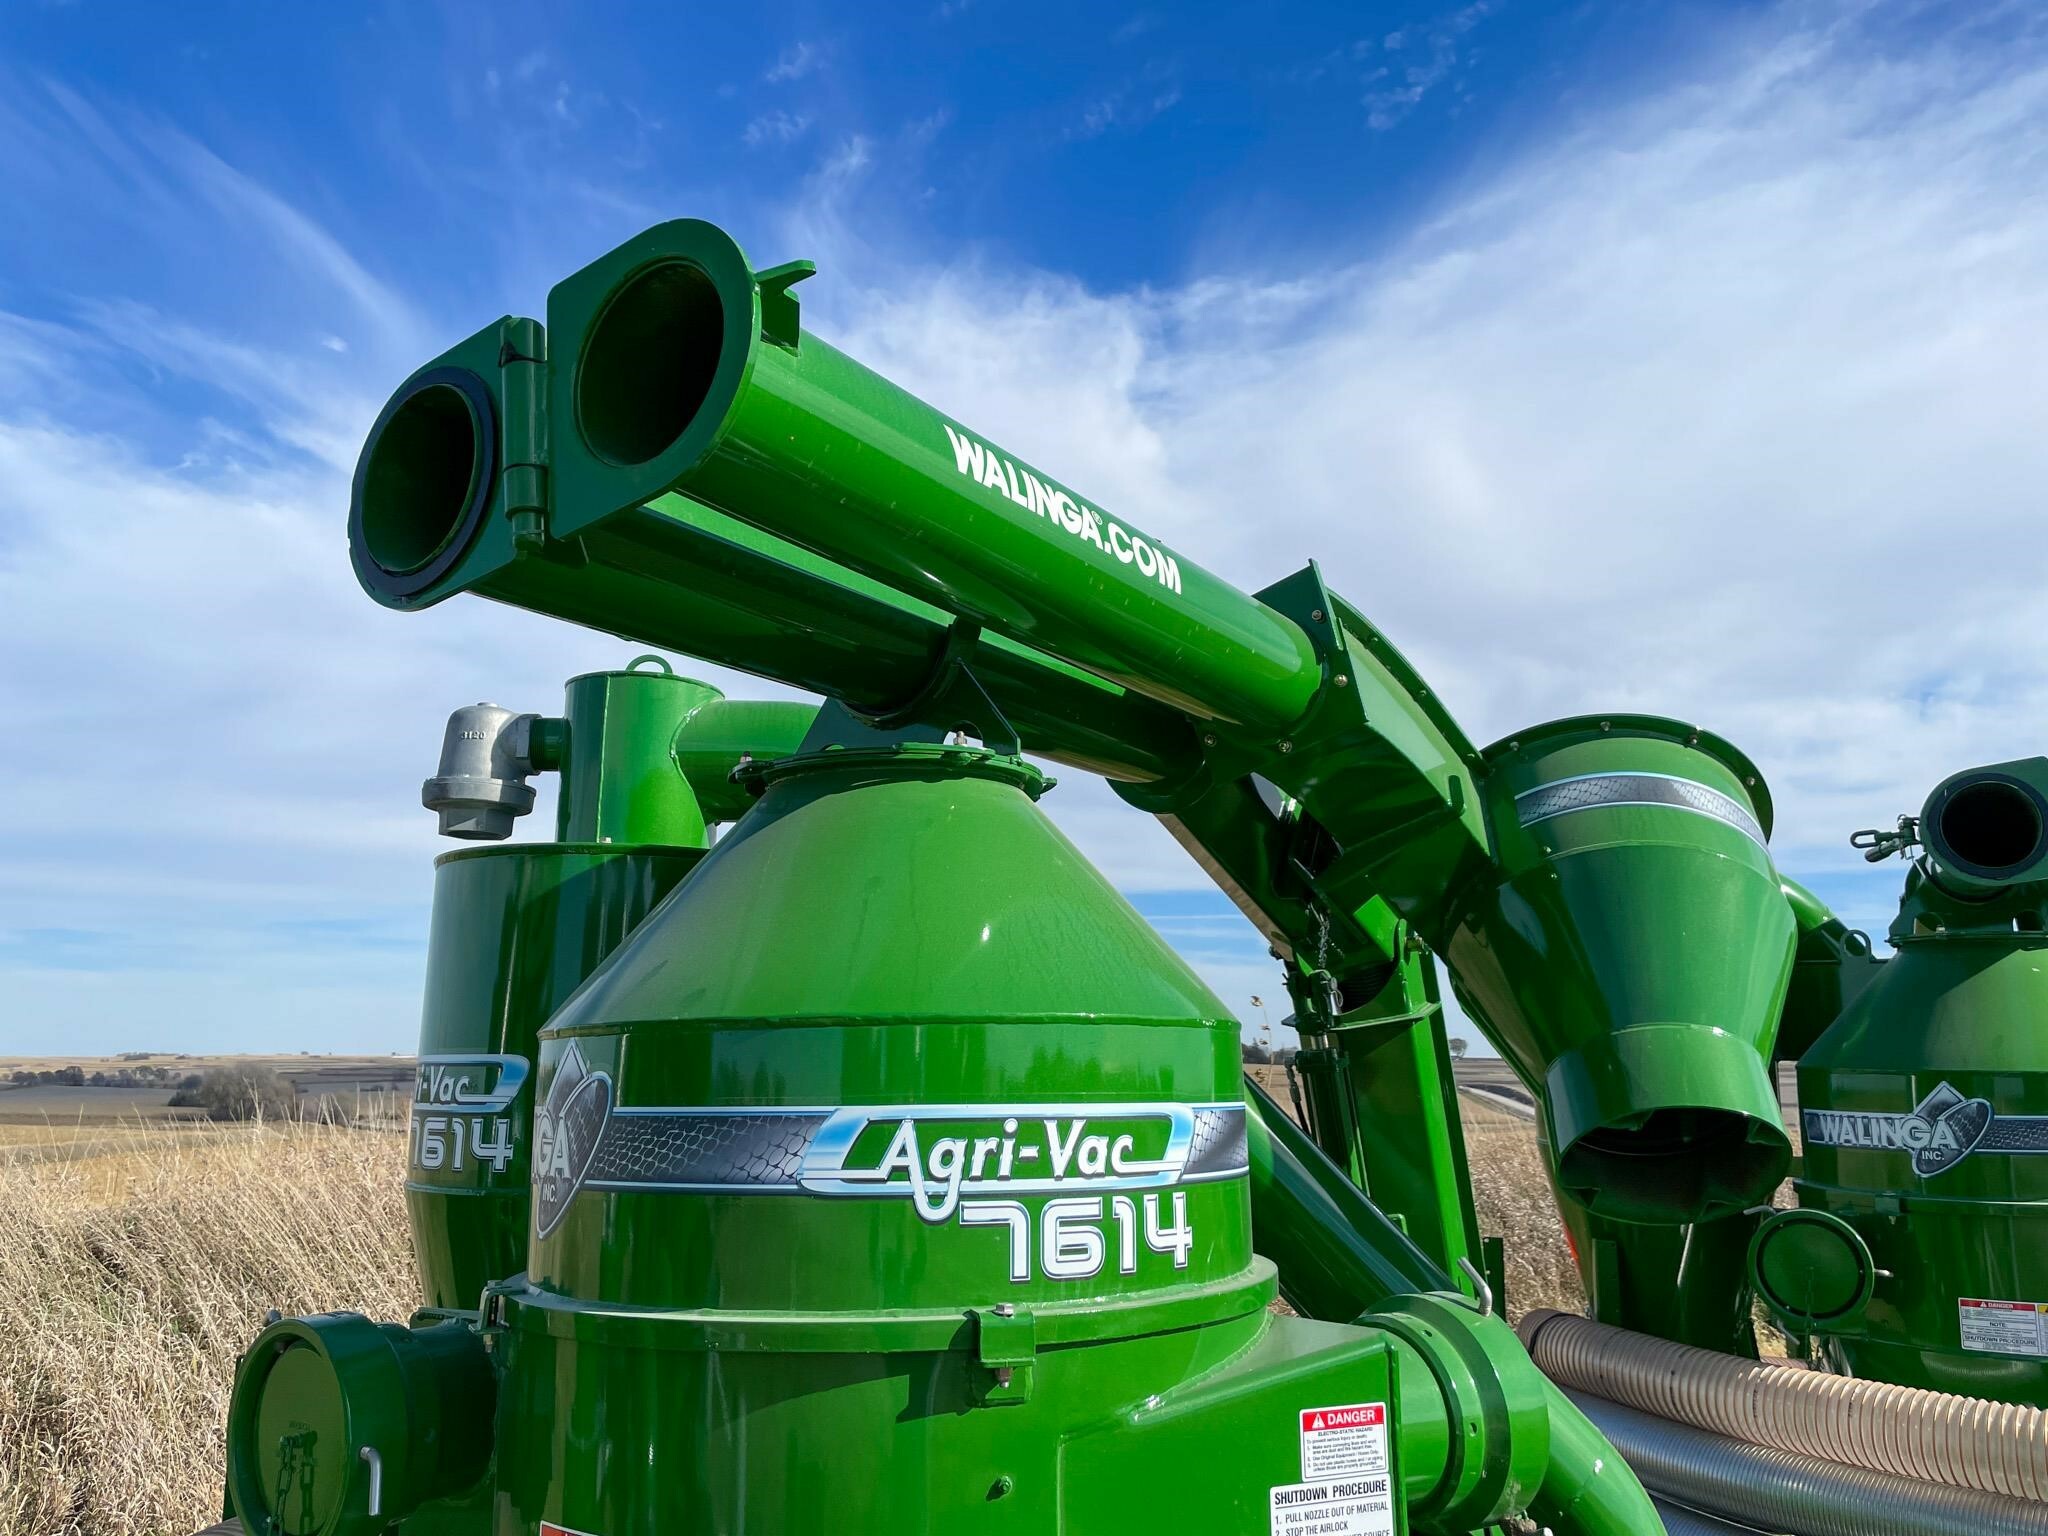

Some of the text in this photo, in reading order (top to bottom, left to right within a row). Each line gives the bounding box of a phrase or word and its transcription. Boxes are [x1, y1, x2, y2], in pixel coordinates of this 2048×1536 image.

[1820, 1115, 1960, 1150] WALINGA
[1921, 1150, 1945, 1161] INC.
[874, 1117, 1146, 1222] Agri-Vac
[542, 1184, 557, 1203] INC.
[959, 1192, 1193, 1282] 7614
[1964, 1334, 1997, 1343] SHUTDOWN
[1327, 1410, 1375, 1426] DANGER
[1274, 1480, 1387, 1505] SHUTDOWN PROCEDURE
[1275, 1501, 1389, 1525] 1. PULL NOZZLE OUT OF MATERIAL
[1286, 1526, 1304, 1536] STOP
[1305, 1524, 1318, 1536] THE
[1320, 1520, 1349, 1534] AIRLOCK
